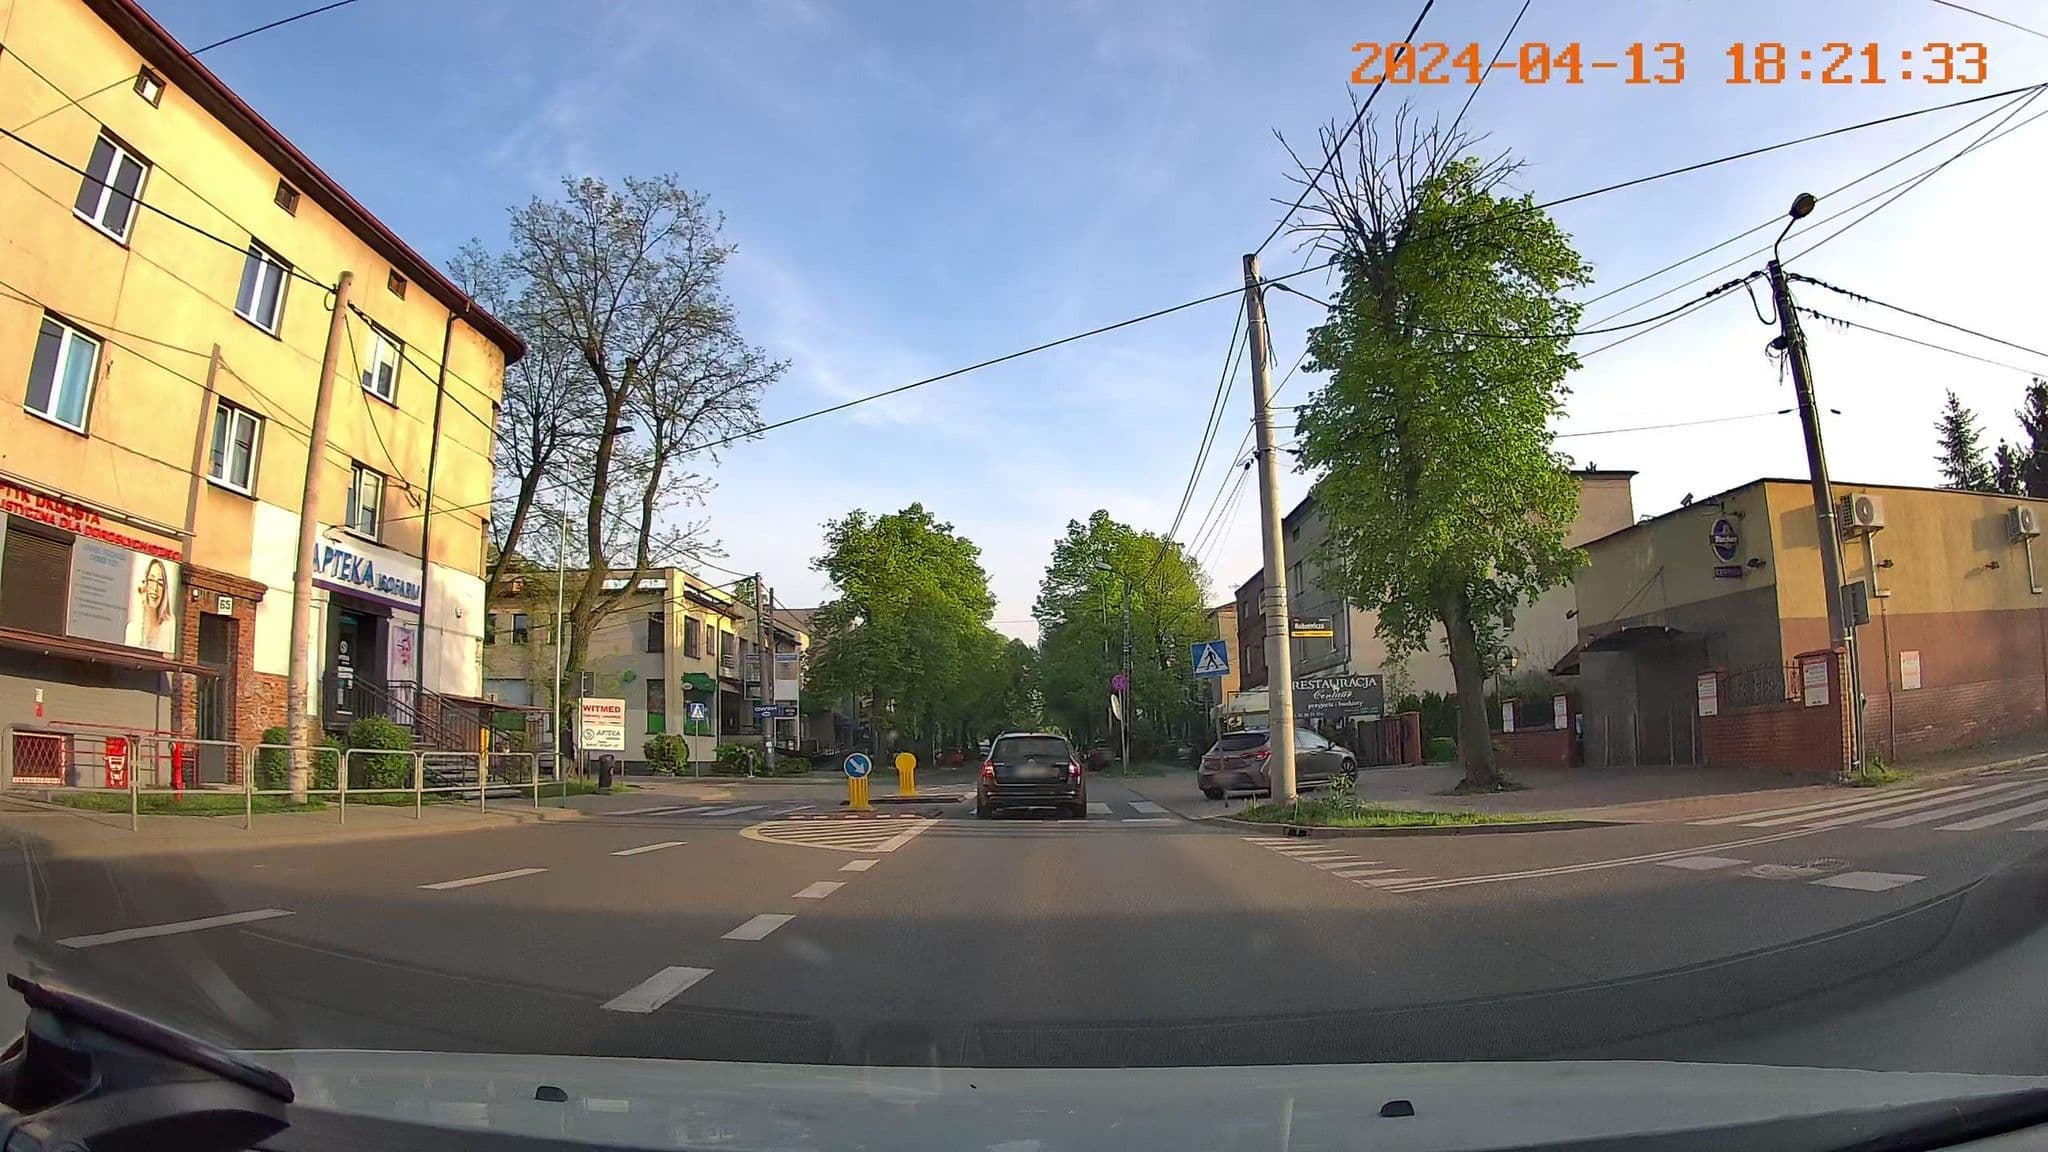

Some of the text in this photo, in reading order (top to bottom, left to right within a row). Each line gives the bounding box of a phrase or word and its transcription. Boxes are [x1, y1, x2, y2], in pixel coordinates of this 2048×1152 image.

[313, 542, 374, 589] APTEKA
[220, 599, 231, 610] 65
[1293, 677, 1377, 691] RESTAURACJA
[583, 704, 621, 713] WITMED
